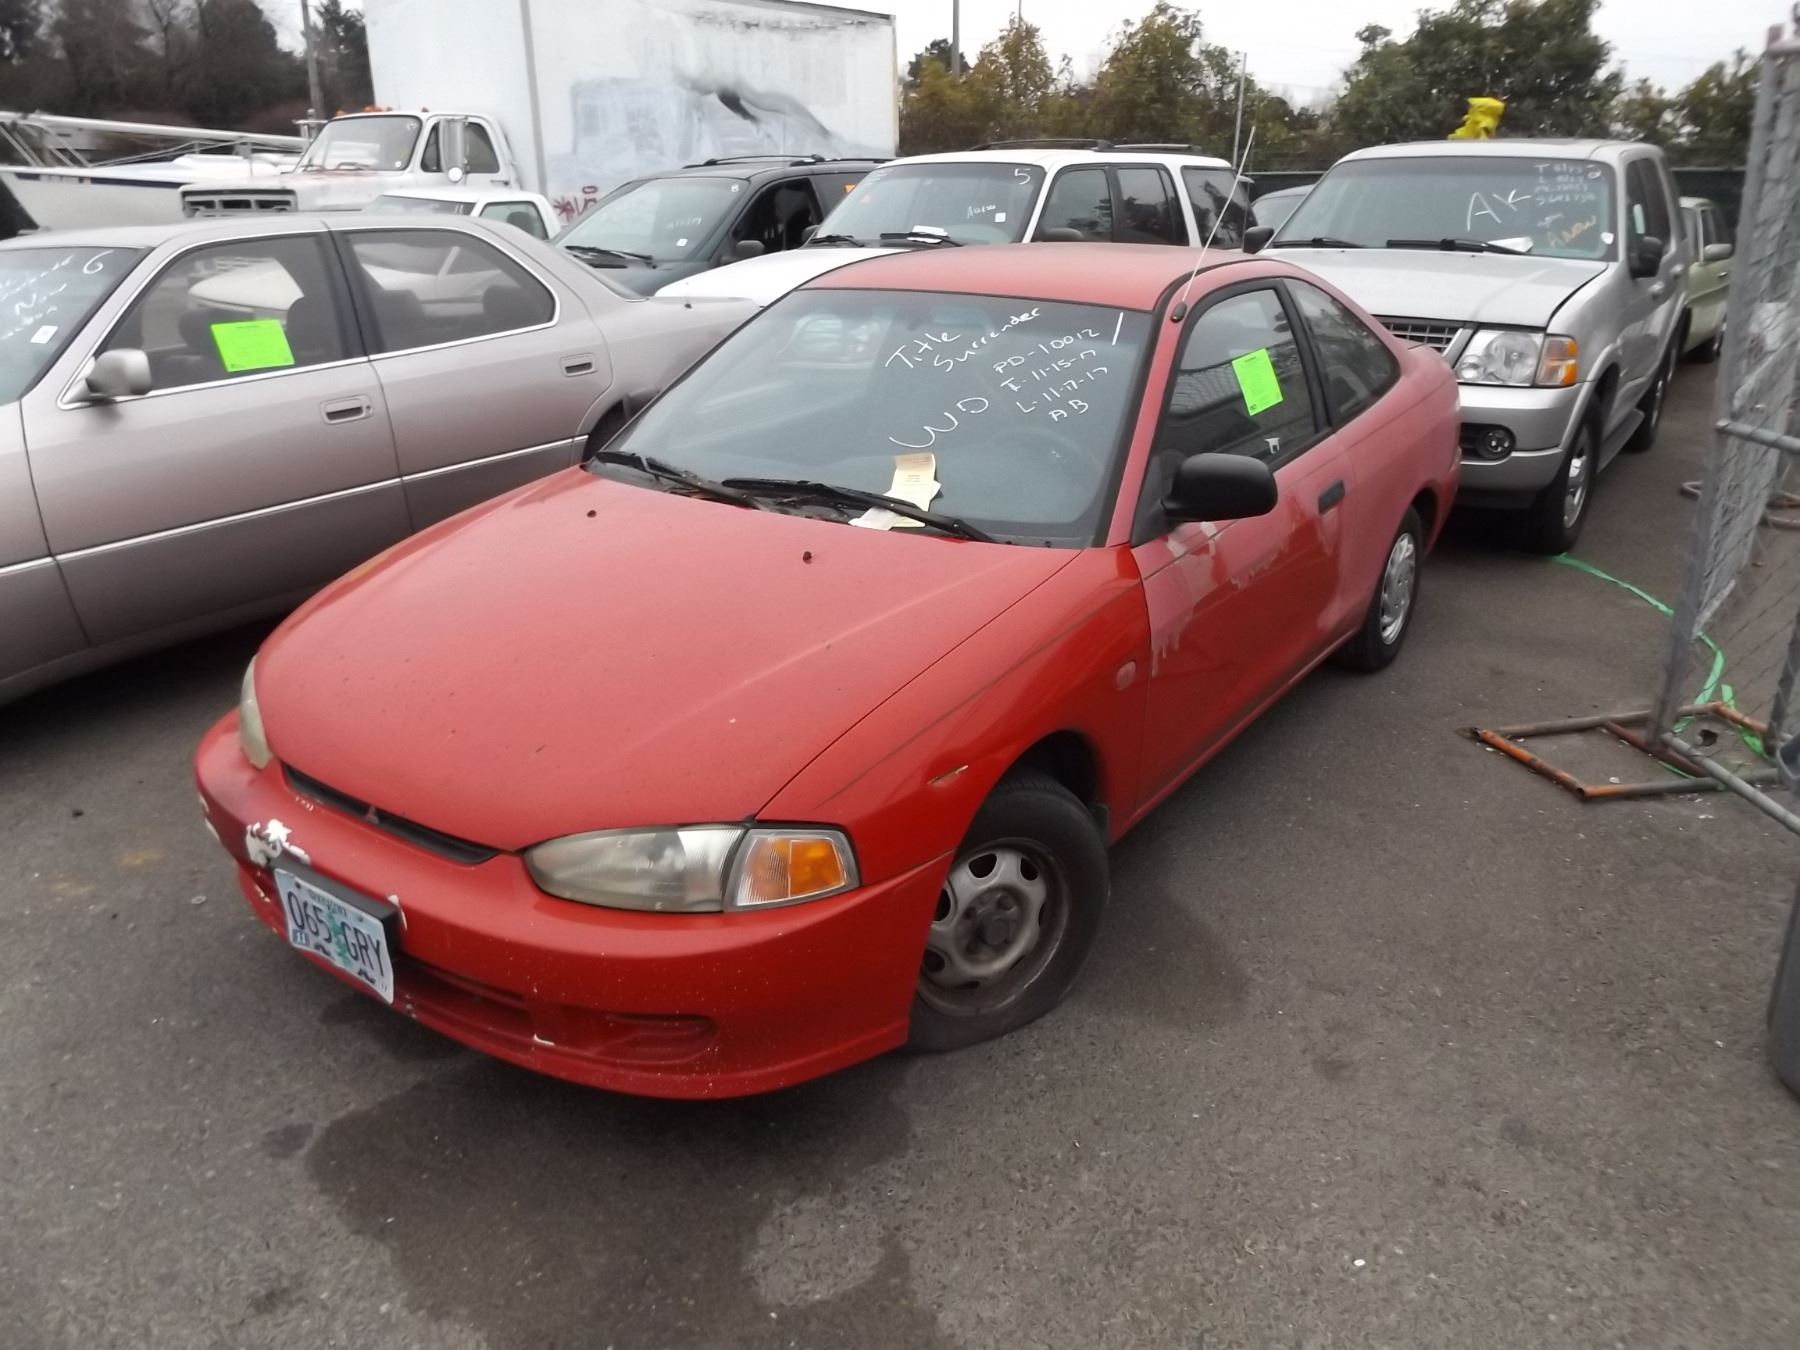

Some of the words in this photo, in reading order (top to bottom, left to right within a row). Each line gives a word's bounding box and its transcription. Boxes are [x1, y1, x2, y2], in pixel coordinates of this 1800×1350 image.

[1014, 168, 1031, 185] 5
[83, 249, 114, 274] 6
[885, 332, 962, 368] Title
[932, 307, 1041, 372] Surrender
[287, 891, 333, 944] 065
[340, 921, 385, 978] GRY
